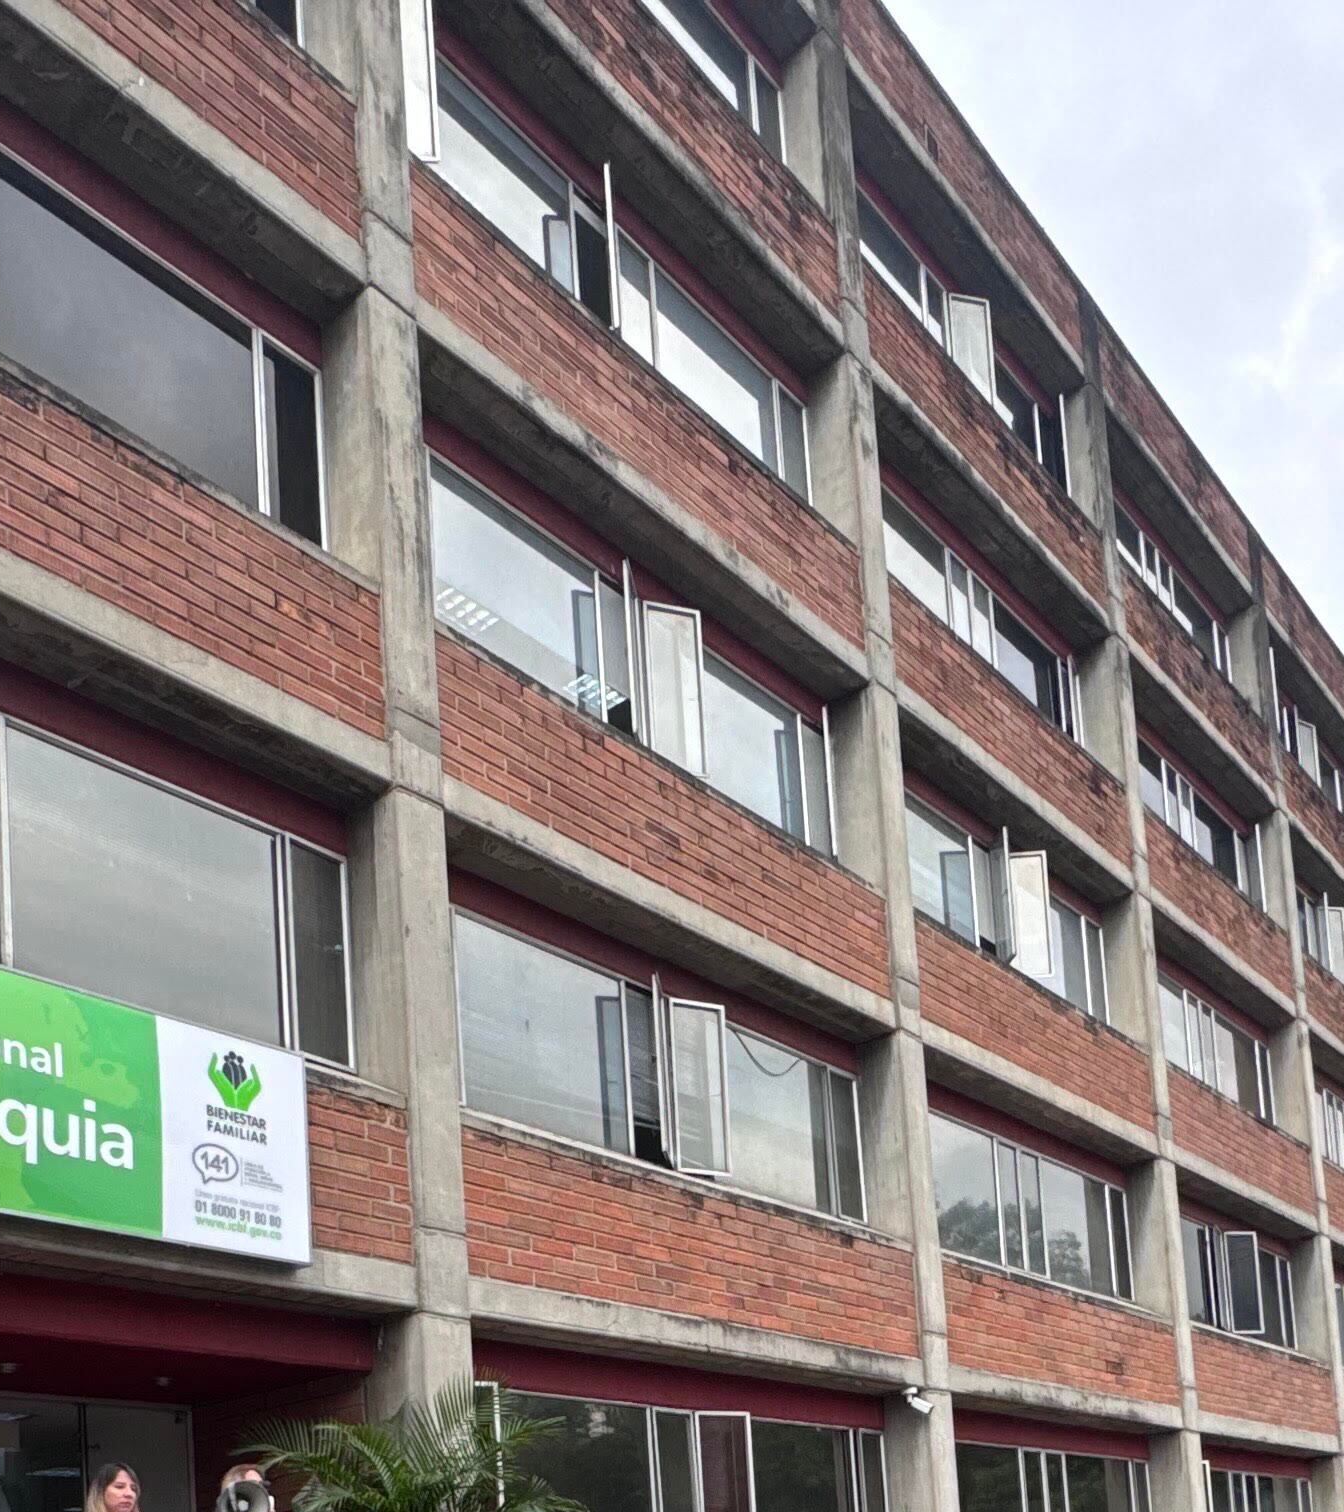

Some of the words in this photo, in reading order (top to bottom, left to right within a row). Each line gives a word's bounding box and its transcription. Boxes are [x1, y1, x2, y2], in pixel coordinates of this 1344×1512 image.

[206, 1104, 267, 1130] BIENESTAR
[207, 1119, 267, 1145] FAMILIAR
[200, 1151, 229, 1175] 141
[195, 1200, 208, 1214] 01
[211, 1202, 237, 1219] 8000
[239, 1209, 251, 1222] 91
